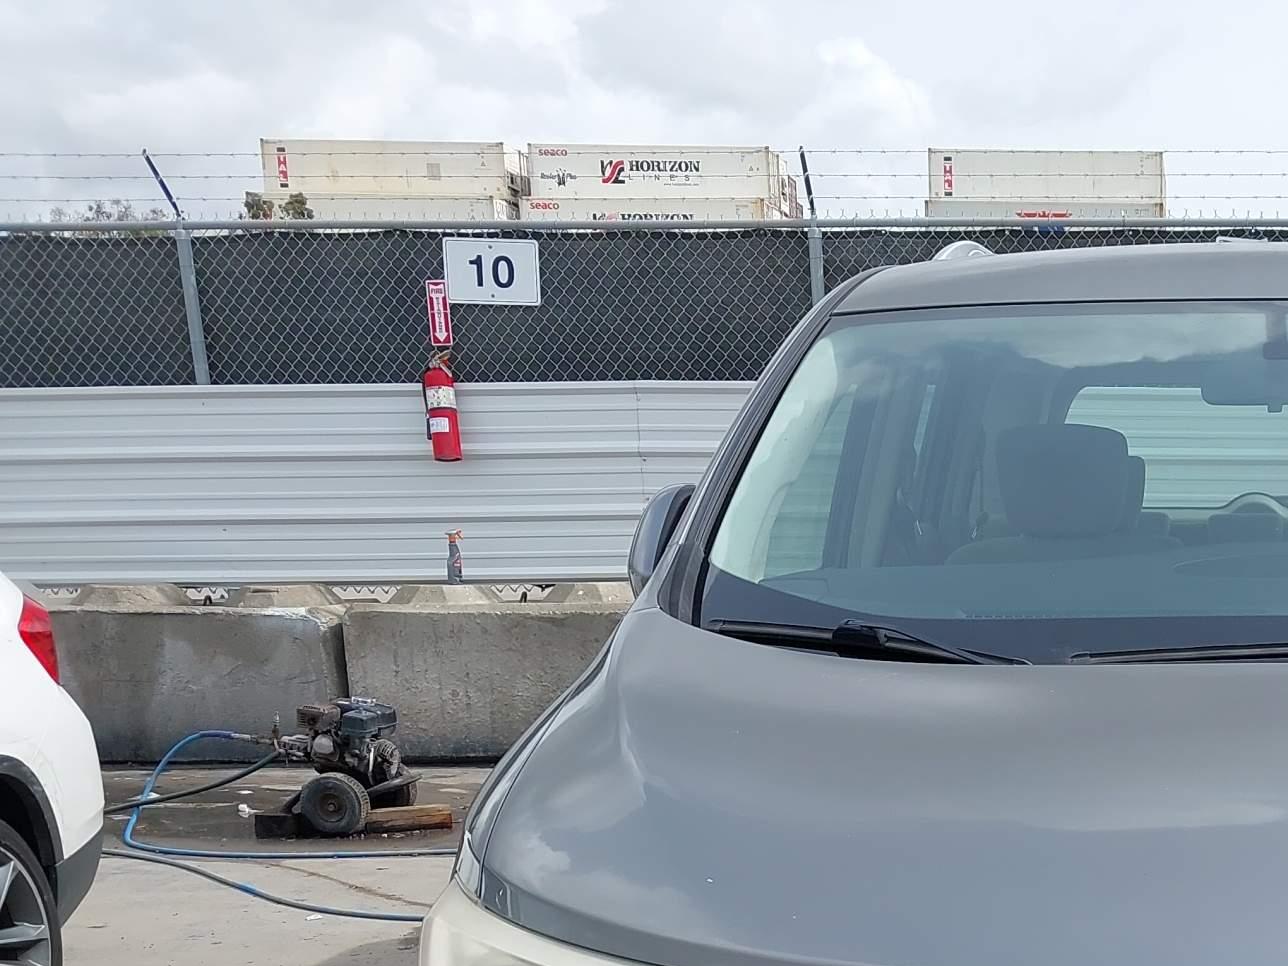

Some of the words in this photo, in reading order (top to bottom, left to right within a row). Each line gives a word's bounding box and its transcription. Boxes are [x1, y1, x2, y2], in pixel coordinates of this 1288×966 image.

[538, 149, 568, 157] seaco
[628, 160, 700, 172] HORIZON
[628, 174, 690, 182] LINES
[529, 202, 560, 210] seaco
[468, 254, 515, 289] 10
